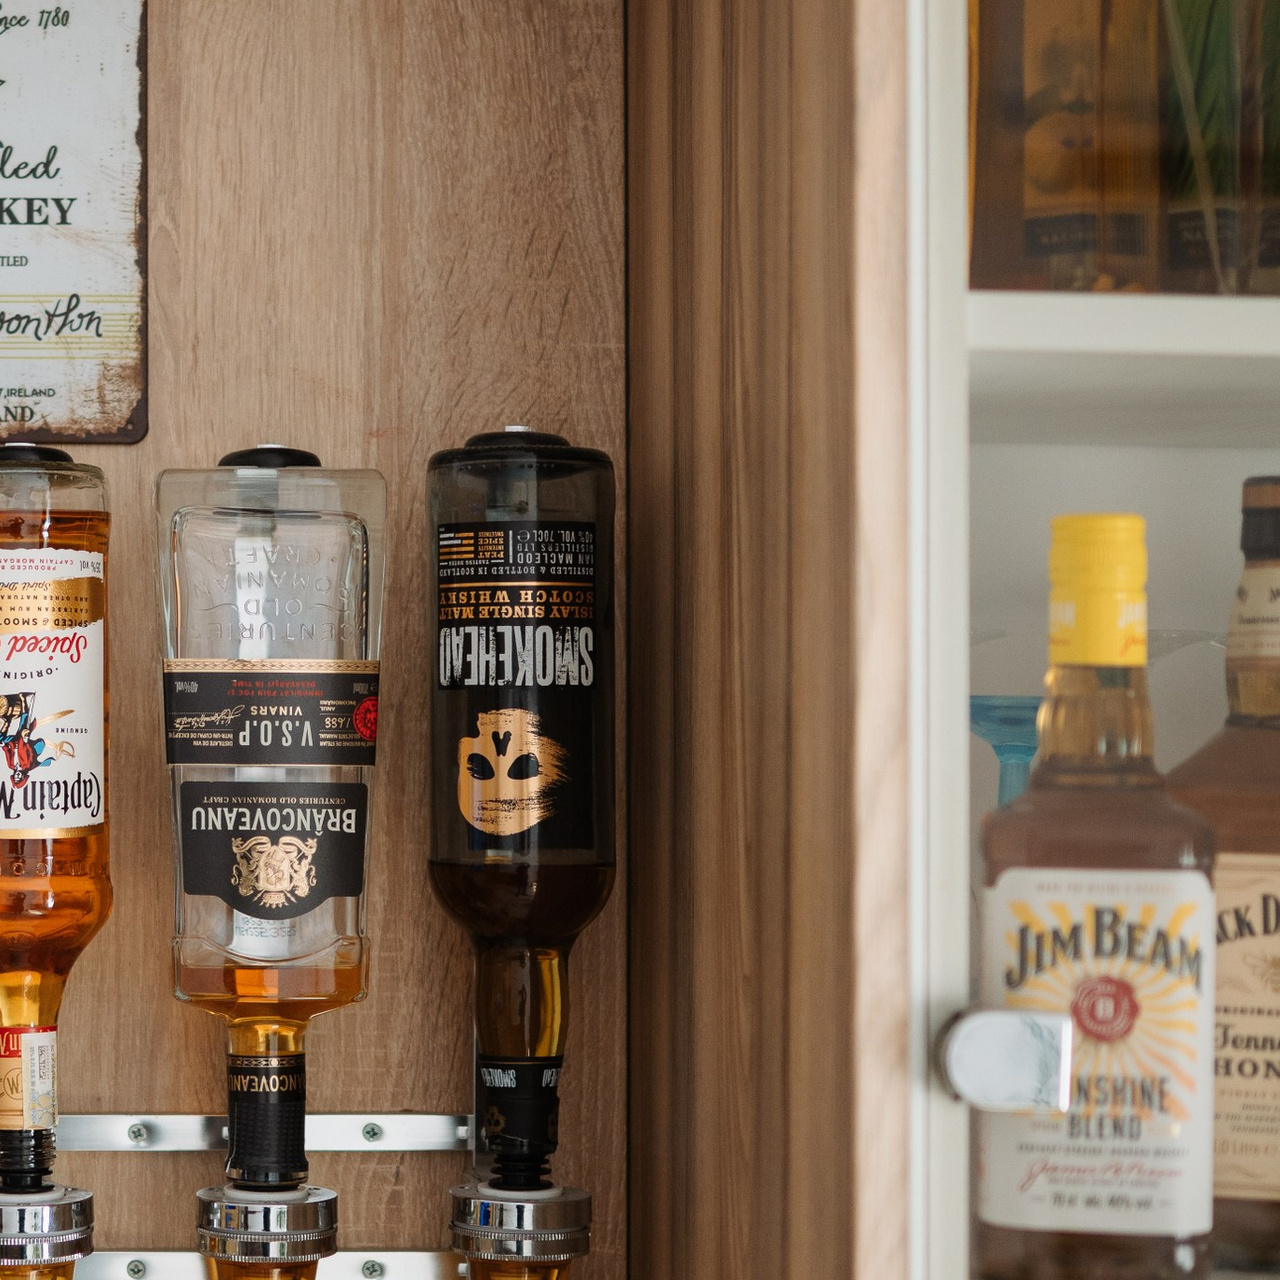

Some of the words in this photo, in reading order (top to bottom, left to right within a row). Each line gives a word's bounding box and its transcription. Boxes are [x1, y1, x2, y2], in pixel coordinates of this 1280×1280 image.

[54, 618, 88, 627] SPICED
[440, 606, 474, 618] MALT
[480, 606, 545, 618] SINGLE
[5, 632, 87, 663] Spiced
[440, 626, 593, 686] SMOKEHEAD
[250, 706, 302, 716] VINARS
[238, 720, 313, 746] V.S.O.P
[23, 771, 100, 820] Captain
[192, 807, 356, 836] BRÂNCOVEANU
[1005, 921, 1082, 989] JIM
[1094, 906, 1202, 993] BEAM
[1075, 1075, 1169, 1114] NSHINE
[1068, 1115, 1142, 1142] BLEND
